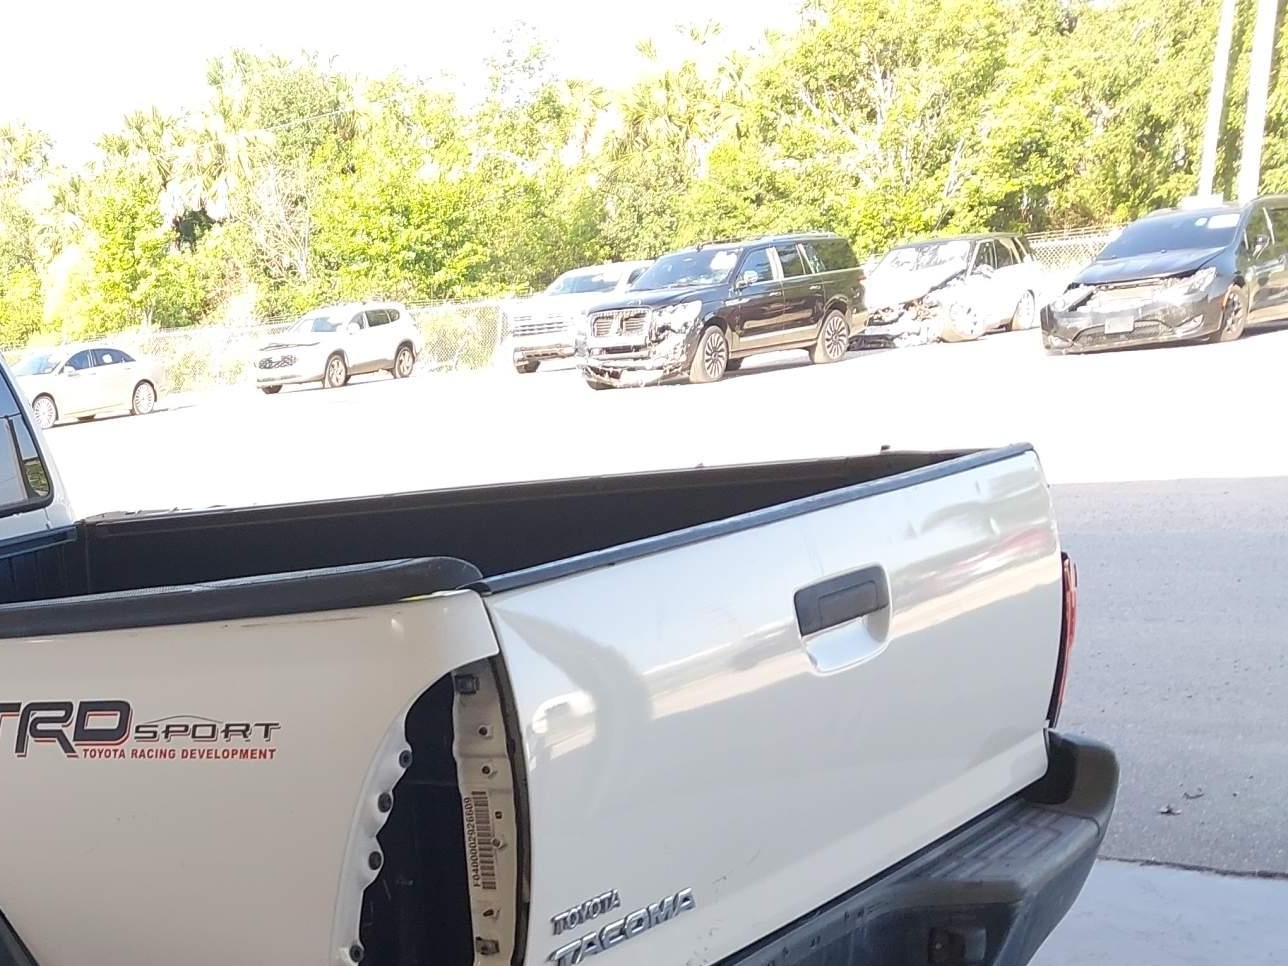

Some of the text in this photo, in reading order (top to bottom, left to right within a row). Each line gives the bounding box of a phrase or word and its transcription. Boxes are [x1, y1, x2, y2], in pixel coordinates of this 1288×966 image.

[134, 722, 280, 742] SPORT
[83, 748, 277, 759] TOYOTA RACING DEVELOPMENT
[551, 888, 621, 935] TOYOTA
